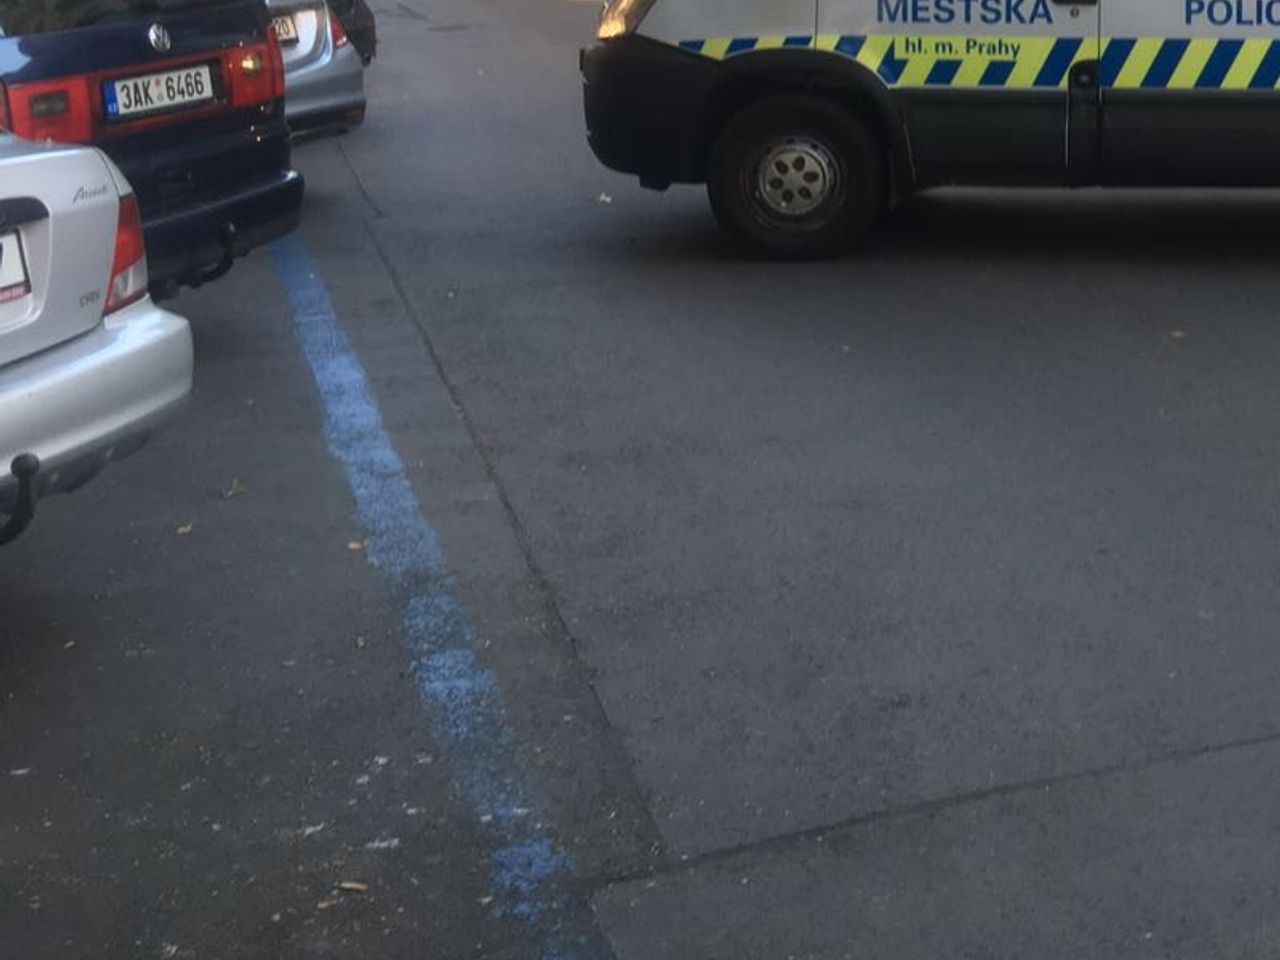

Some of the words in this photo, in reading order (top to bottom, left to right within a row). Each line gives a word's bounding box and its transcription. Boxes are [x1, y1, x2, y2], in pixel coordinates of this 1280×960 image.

[905, 37, 927, 54] hl.
[935, 41, 959, 54] m.
[966, 37, 1020, 59] Prahy
[120, 78, 154, 109] 3AK
[165, 71, 205, 100] 6466
